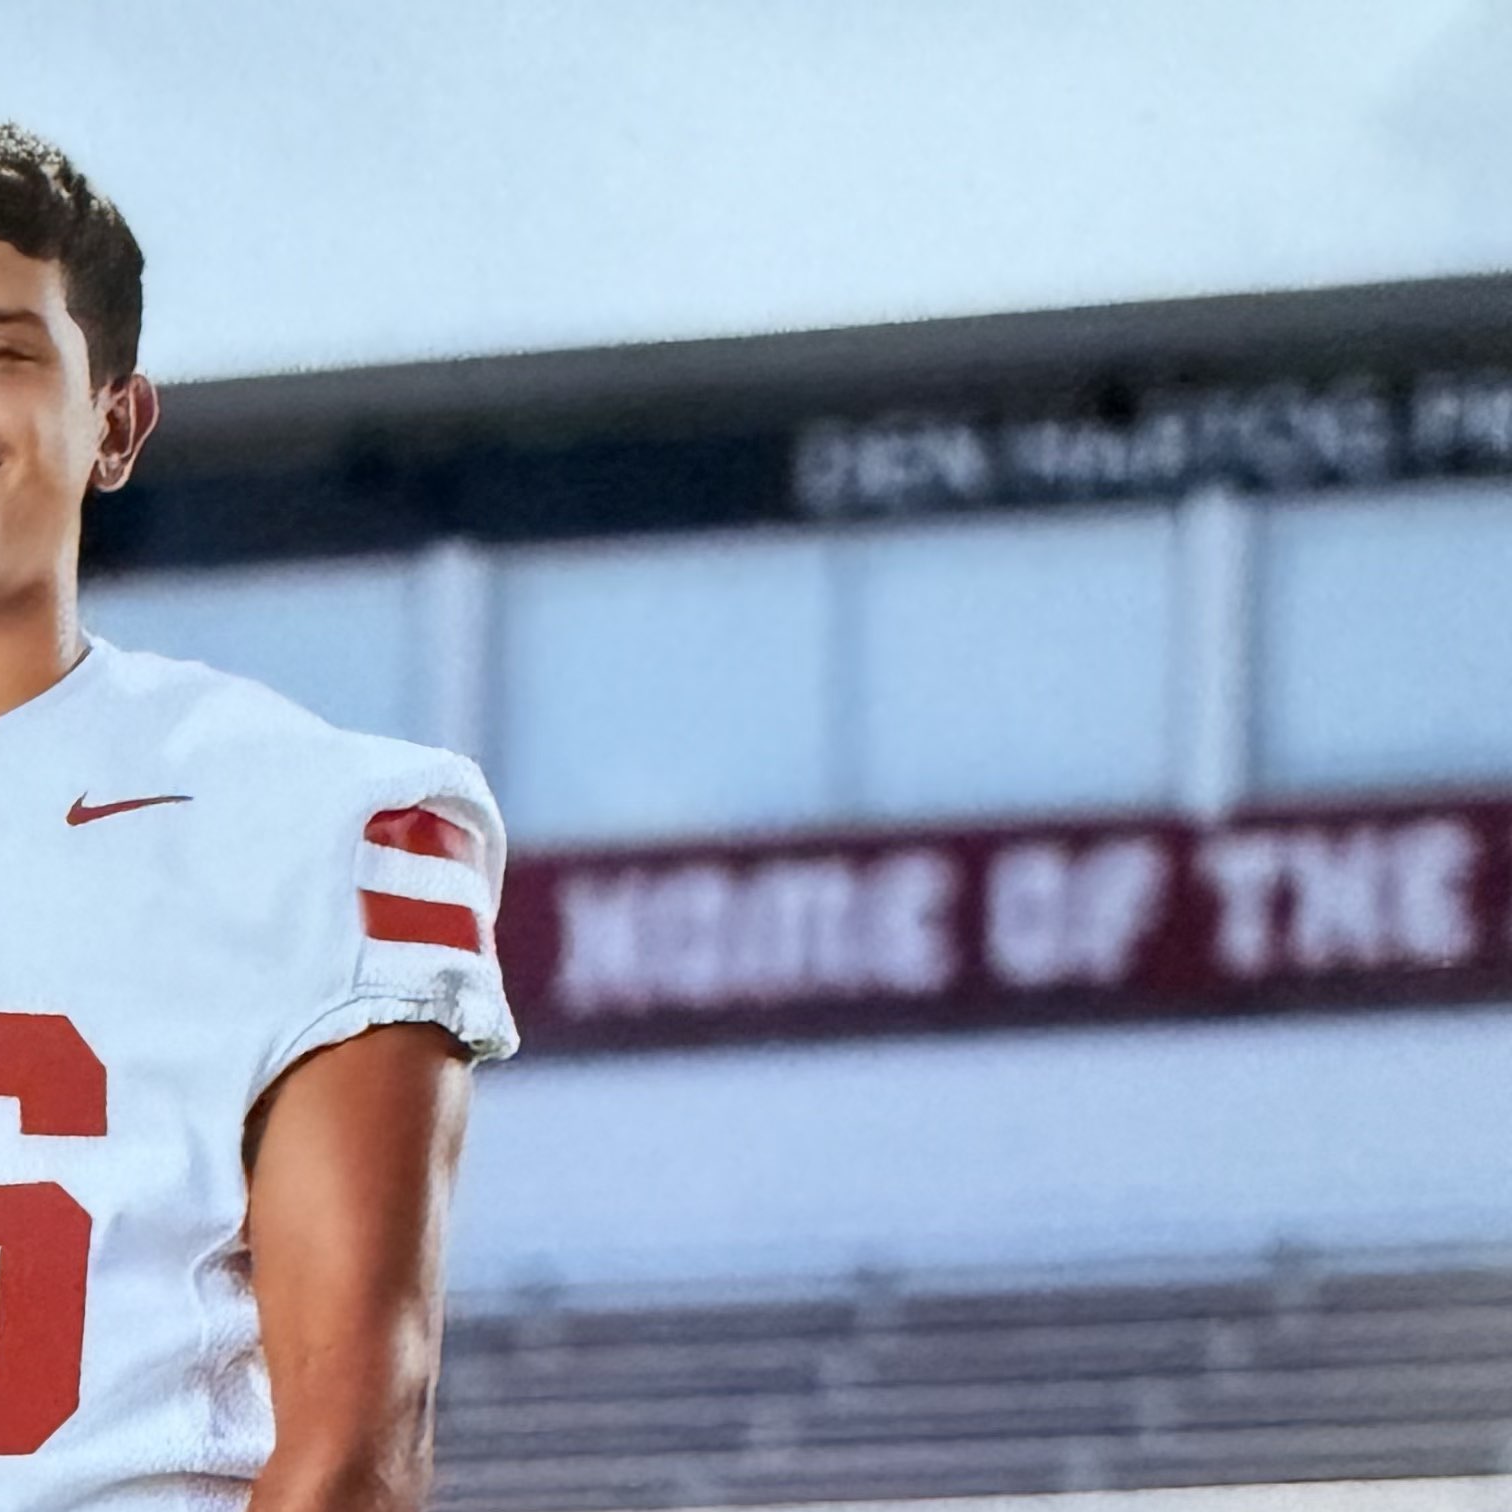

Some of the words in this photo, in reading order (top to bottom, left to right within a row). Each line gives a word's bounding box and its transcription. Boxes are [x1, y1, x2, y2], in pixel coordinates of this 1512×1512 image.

[554, 848, 956, 1020] HOME
[986, 836, 1170, 988] OF
[1194, 818, 1482, 980] THE
